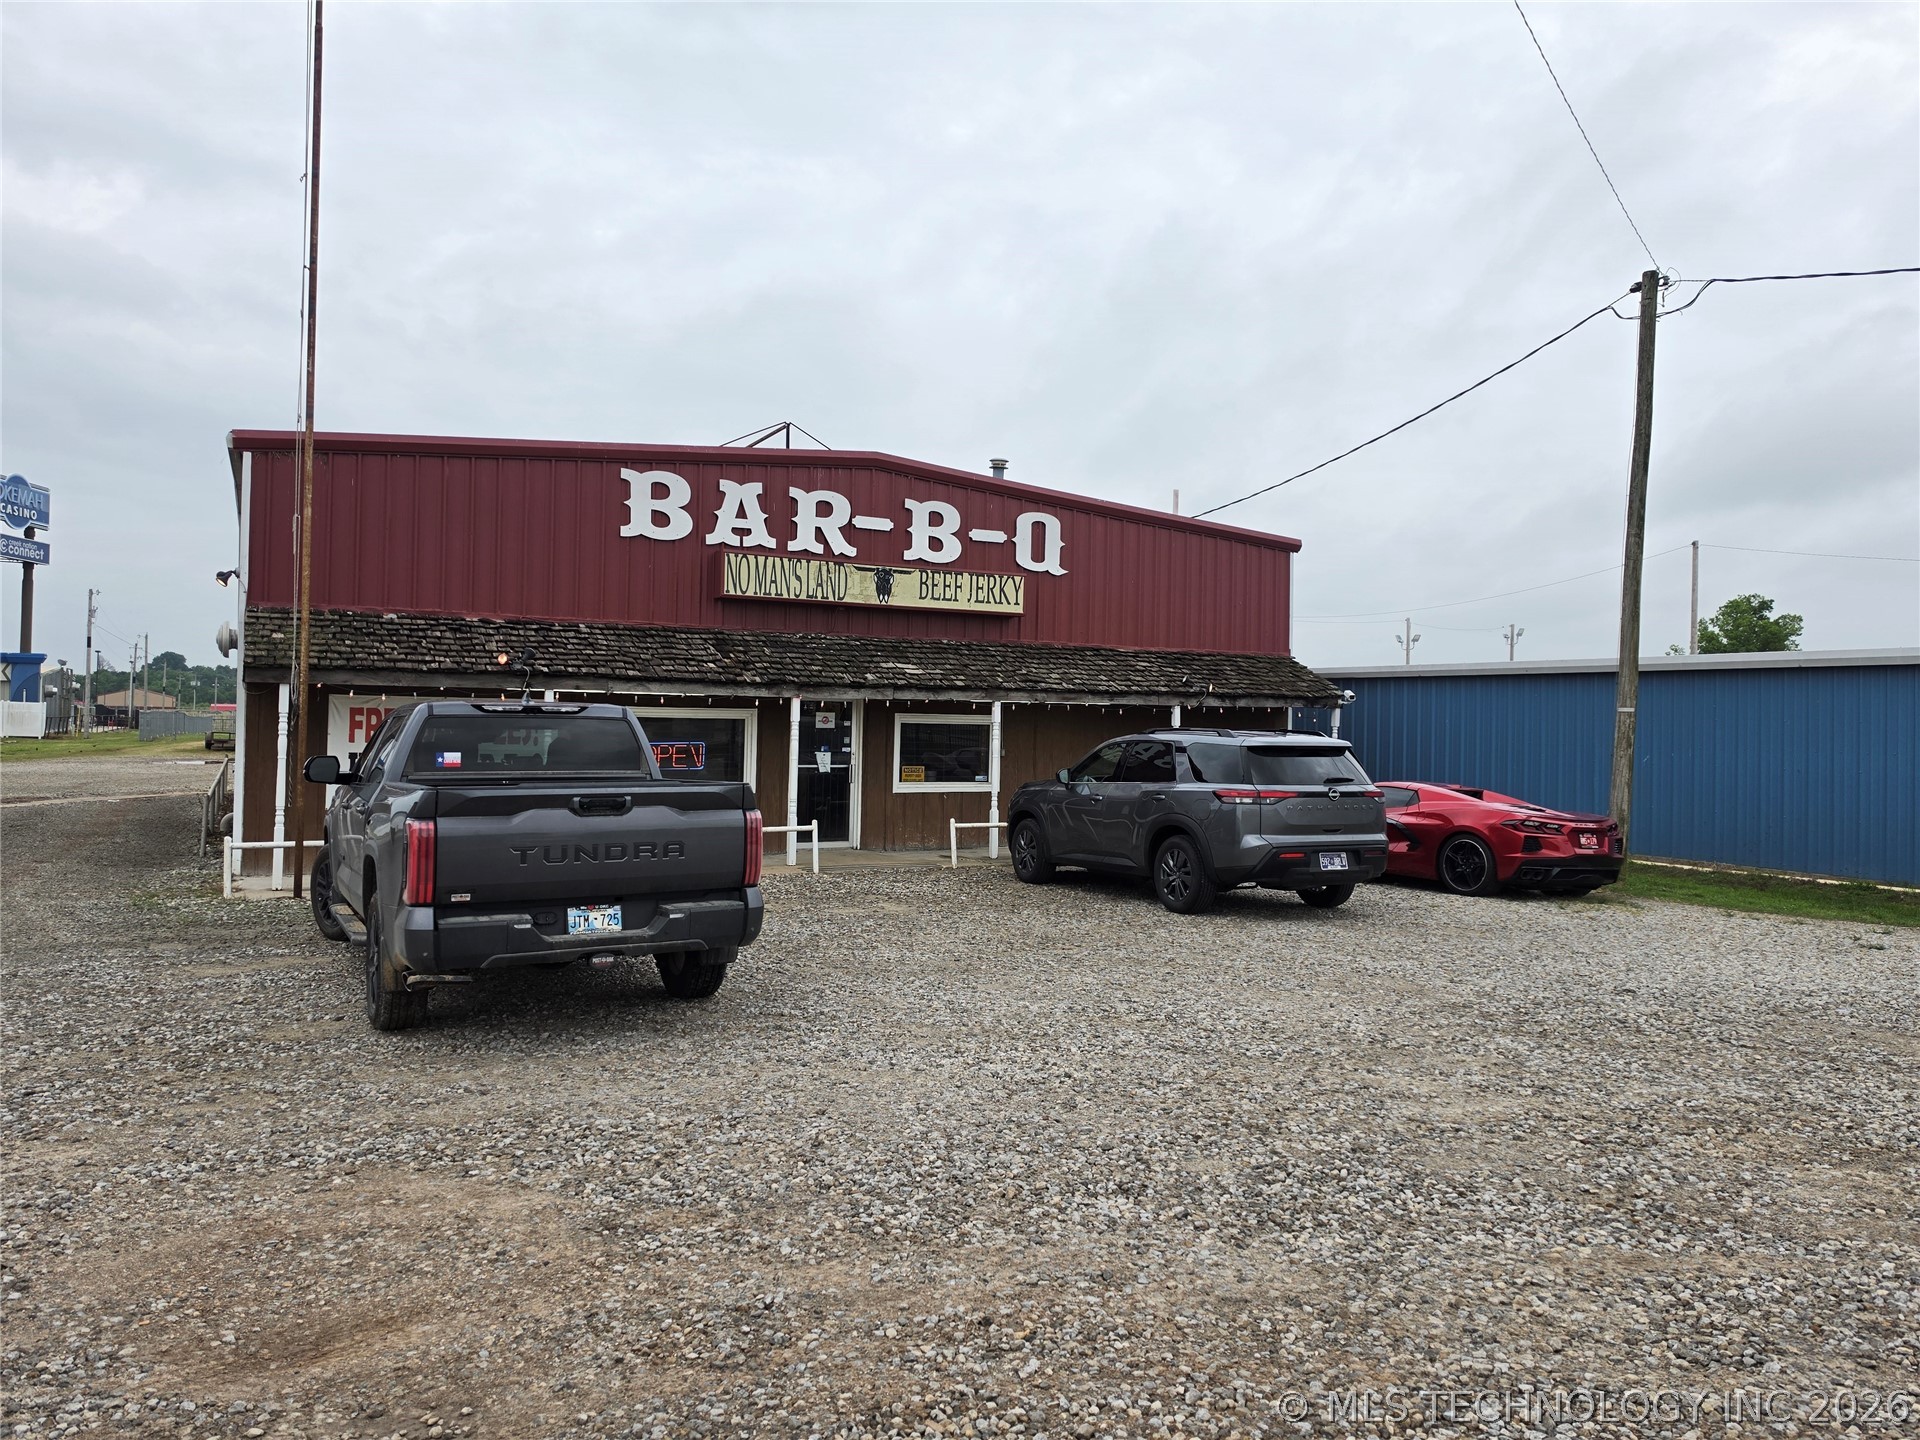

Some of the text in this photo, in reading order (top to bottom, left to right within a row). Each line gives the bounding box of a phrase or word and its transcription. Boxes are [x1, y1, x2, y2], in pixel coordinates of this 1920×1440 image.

[0, 502, 38, 520] CASINO
[619, 467, 1068, 576] BAR-B-Q
[8, 545, 45, 560] connect
[725, 552, 1024, 608] NO MAN'S LAND BEEF JERKY
[509, 840, 686, 867] TUNDRA
